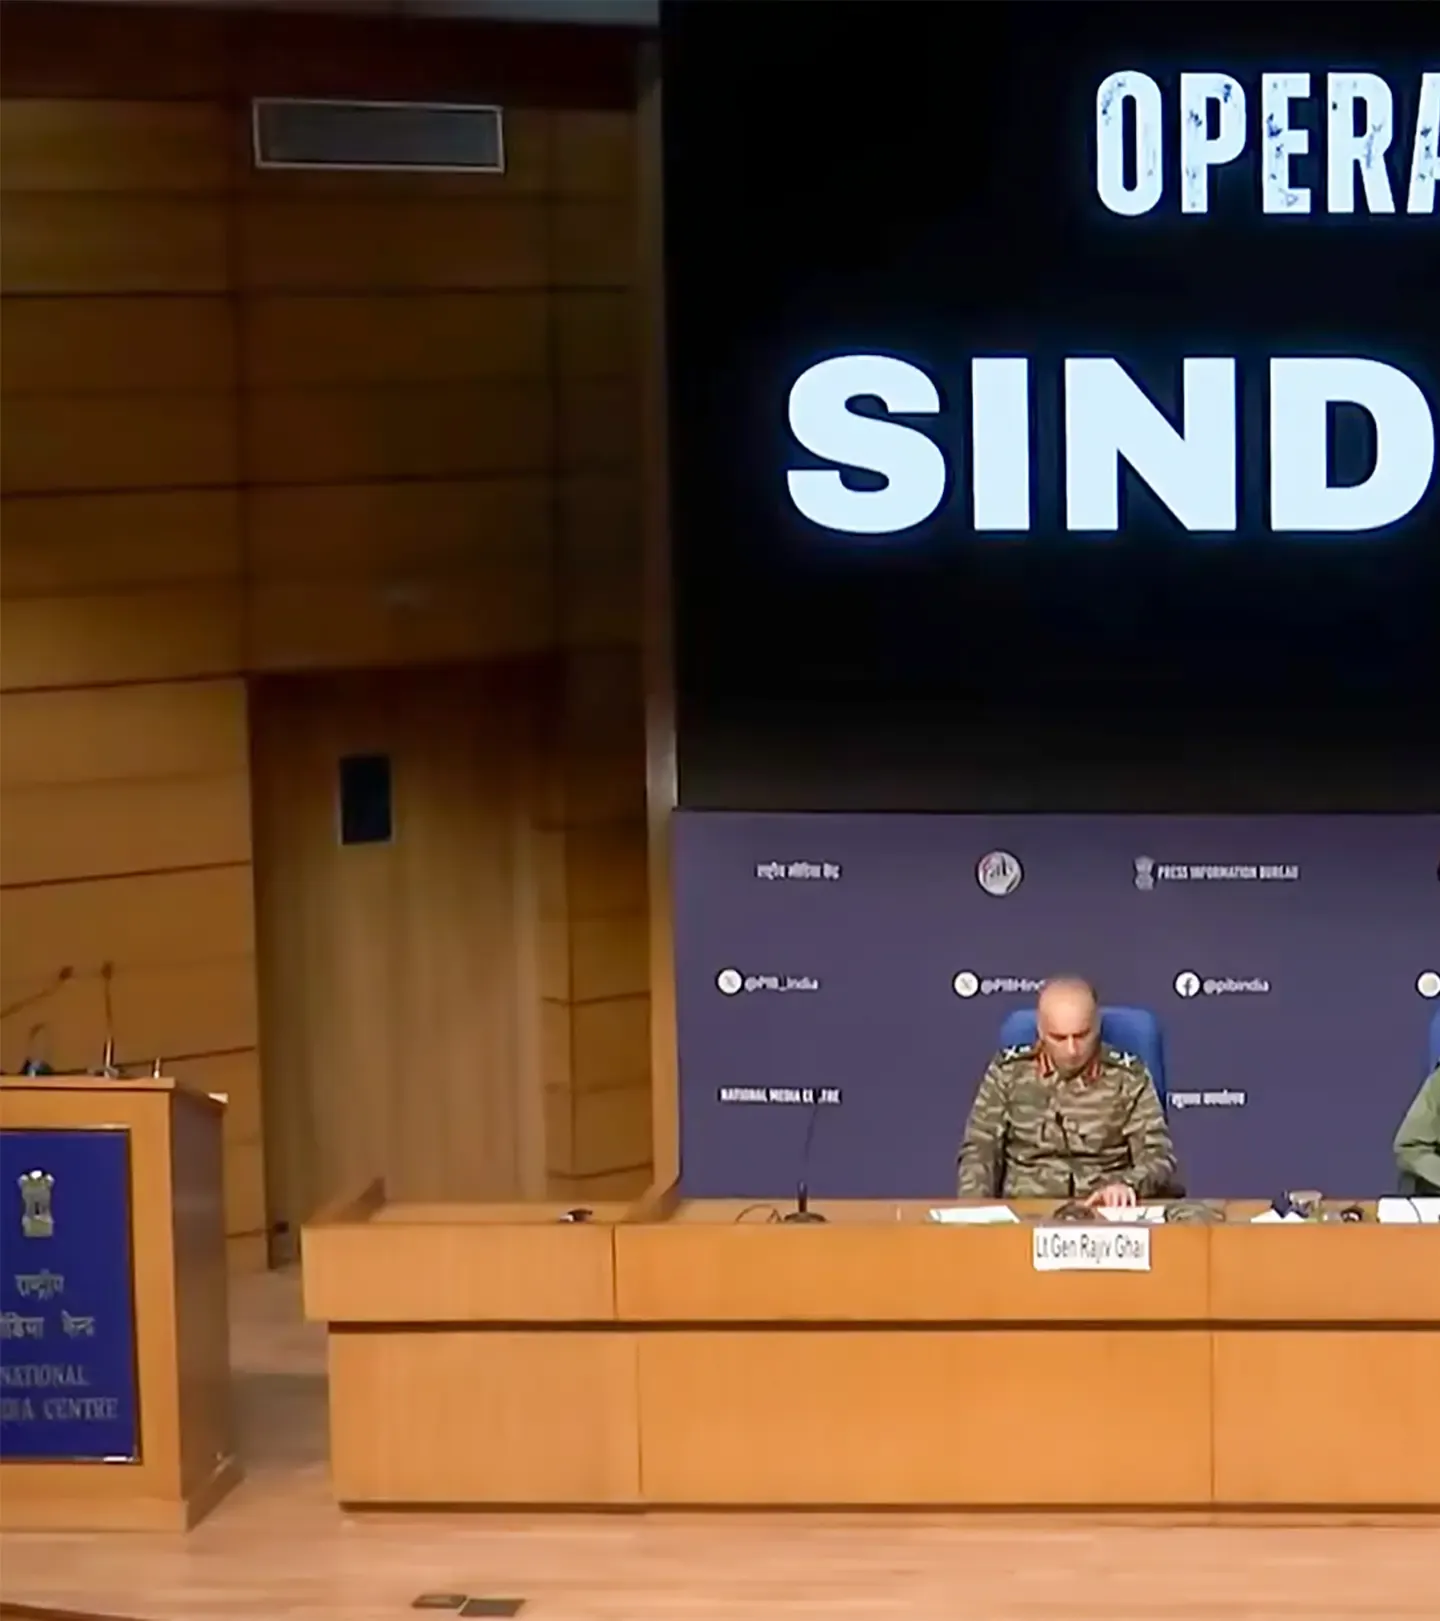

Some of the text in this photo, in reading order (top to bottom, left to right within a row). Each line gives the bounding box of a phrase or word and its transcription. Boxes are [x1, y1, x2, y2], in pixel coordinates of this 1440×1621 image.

[1158, 865, 1299, 879] PRESS INFORMATION BUREAU
[1203, 977, 1270, 995] @pibindia
[721, 1087, 767, 1102] NATIONAL
[769, 1088, 800, 1103] MEDIA
[1036, 1235, 1049, 1258] Lt
[1051, 1233, 1077, 1258] Gen
[1080, 1233, 1112, 1264] Rajiv
[0, 1364, 92, 1388] NATIONAL
[0, 1396, 119, 1421] DIA CENTRE
